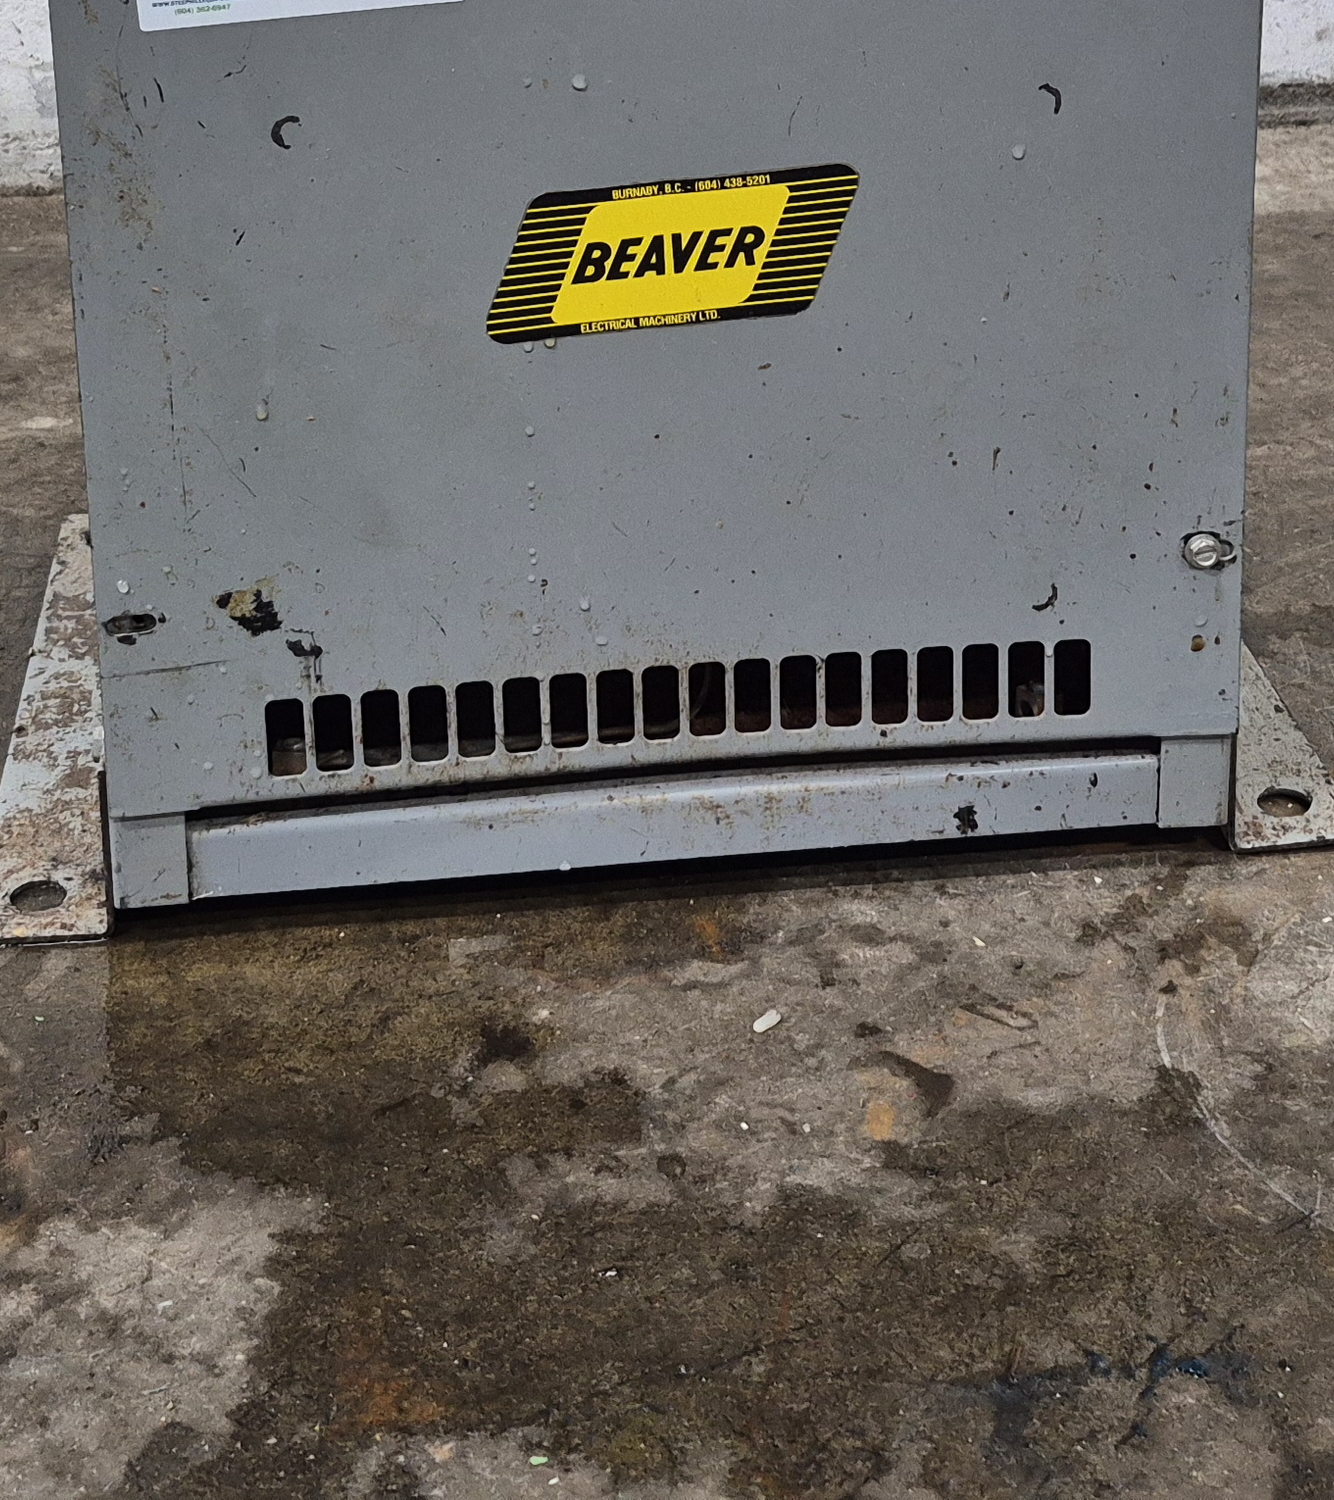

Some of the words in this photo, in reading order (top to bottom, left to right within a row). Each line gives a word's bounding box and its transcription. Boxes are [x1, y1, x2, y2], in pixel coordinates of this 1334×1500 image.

[611, 184, 663, 200] BURNABY,
[664, 182, 685, 194] B.C.
[694, 178, 721, 192] (604)
[723, 173, 771, 188] 438-5201
[571, 224, 766, 286] BEAVER
[580, 317, 638, 334] ELECTRICAL
[638, 311, 698, 328] MACHINERY
[698, 309, 721, 323] LTD.
